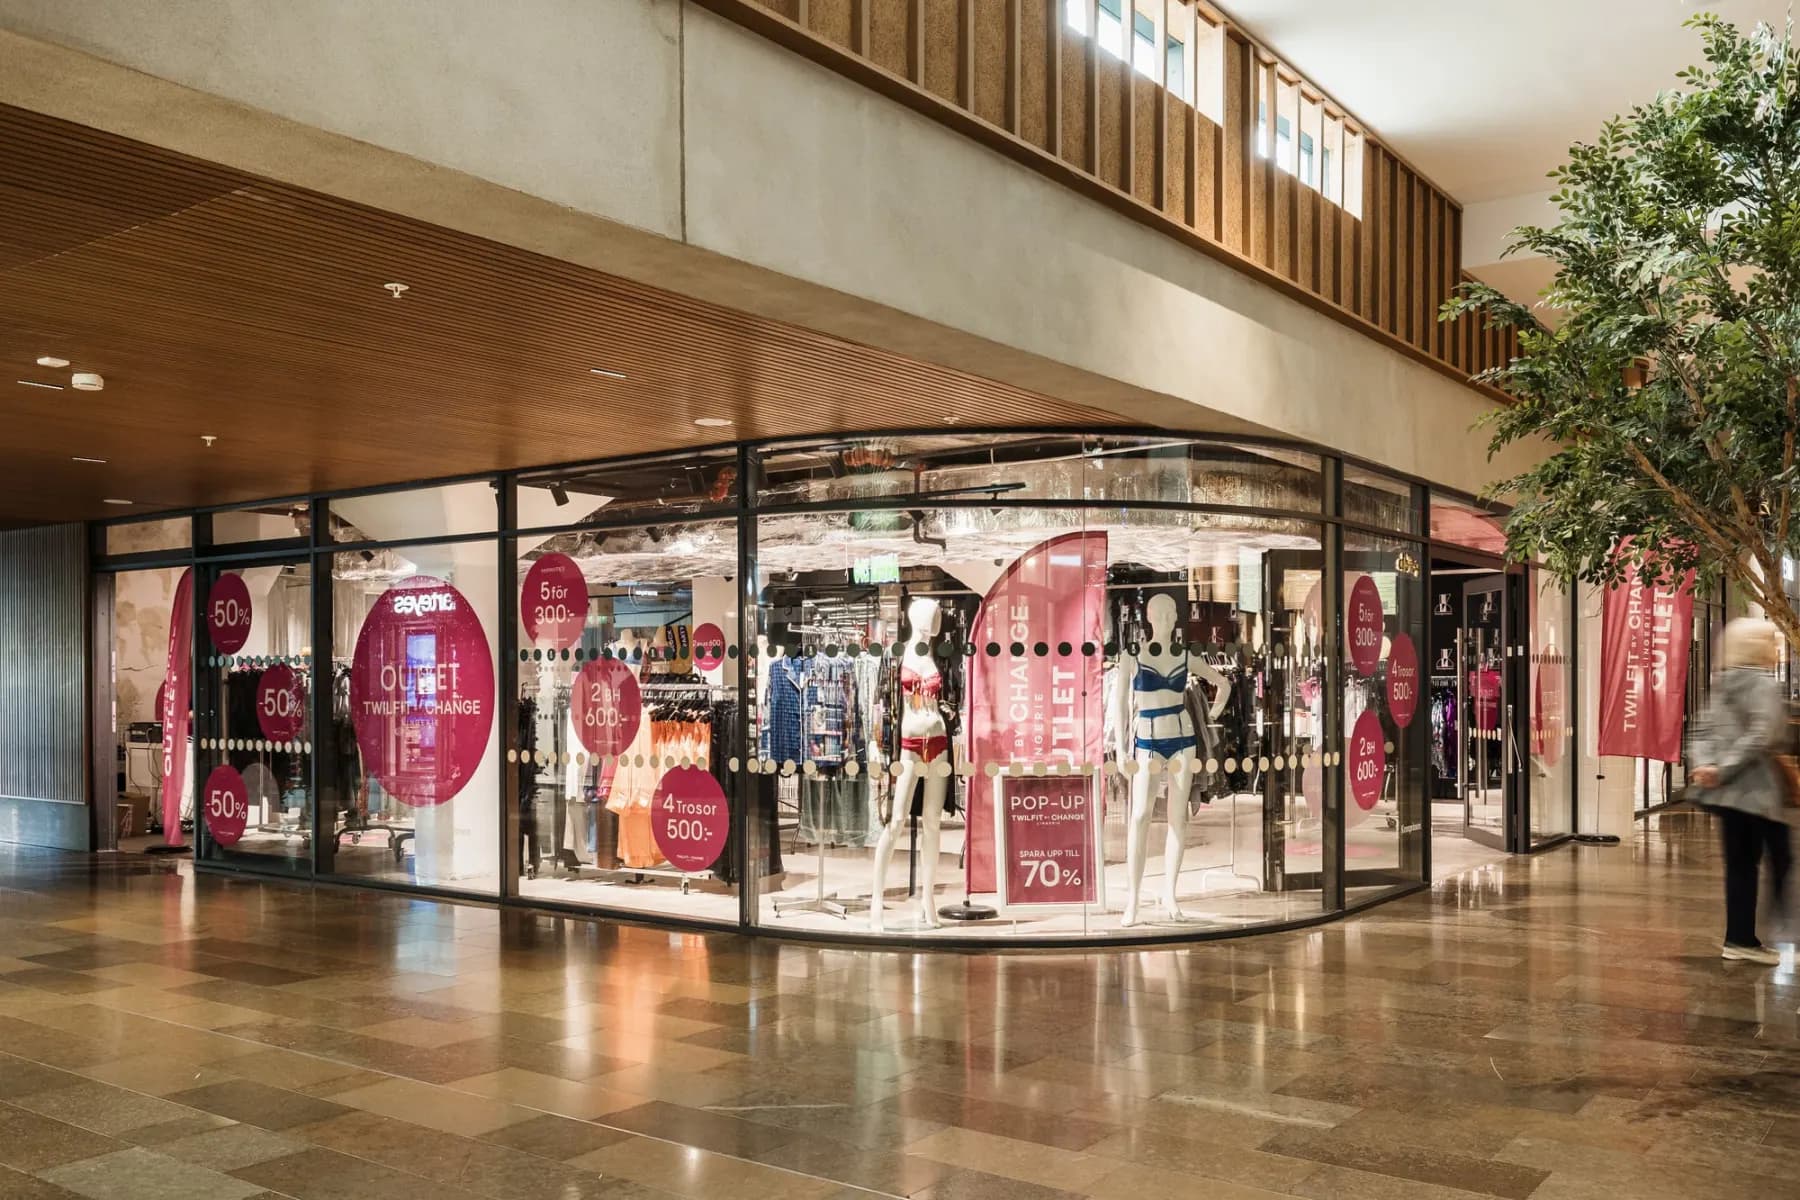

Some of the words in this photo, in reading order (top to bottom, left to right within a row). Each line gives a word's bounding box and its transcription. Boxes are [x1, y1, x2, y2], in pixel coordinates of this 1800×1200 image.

[540, 581, 550, 601] 5
[551, 585, 569, 600] för
[1628, 545, 1644, 629] CHANG
[209, 598, 250, 628] -50%
[534, 604, 575, 625] 300:-
[1359, 603, 1365, 622] 5
[1631, 635, 1637, 648] BY
[1642, 608, 1651, 668] LINGERIE
[1652, 587, 1675, 692] OUTLET
[1391, 659, 1397, 677] 4
[591, 683, 601, 702] 2
[605, 688, 621, 702] BH
[1624, 651, 1640, 732] TWILFIT
[259, 688, 302, 717] -50%
[363, 701, 410, 715] TWILFIT
[425, 700, 481, 715] CHANGE
[585, 707, 628, 727] 600:-
[1052, 665, 1075, 766] UTLET
[1014, 729, 1024, 747] BY
[1359, 737, 1366, 756] 2
[1366, 741, 1375, 755] BH
[1357, 759, 1378, 781] 600:-
[206, 790, 246, 820] -50%
[662, 793, 675, 813] 4
[676, 800, 717, 816] Trosor
[1010, 795, 1084, 811] POP-UP
[1011, 814, 1044, 822] TWILFIT
[667, 818, 713, 842] 500:-
[1020, 850, 1046, 858] SPARA
[1064, 849, 1080, 857] TILL
[1020, 859, 1082, 887] 70%
